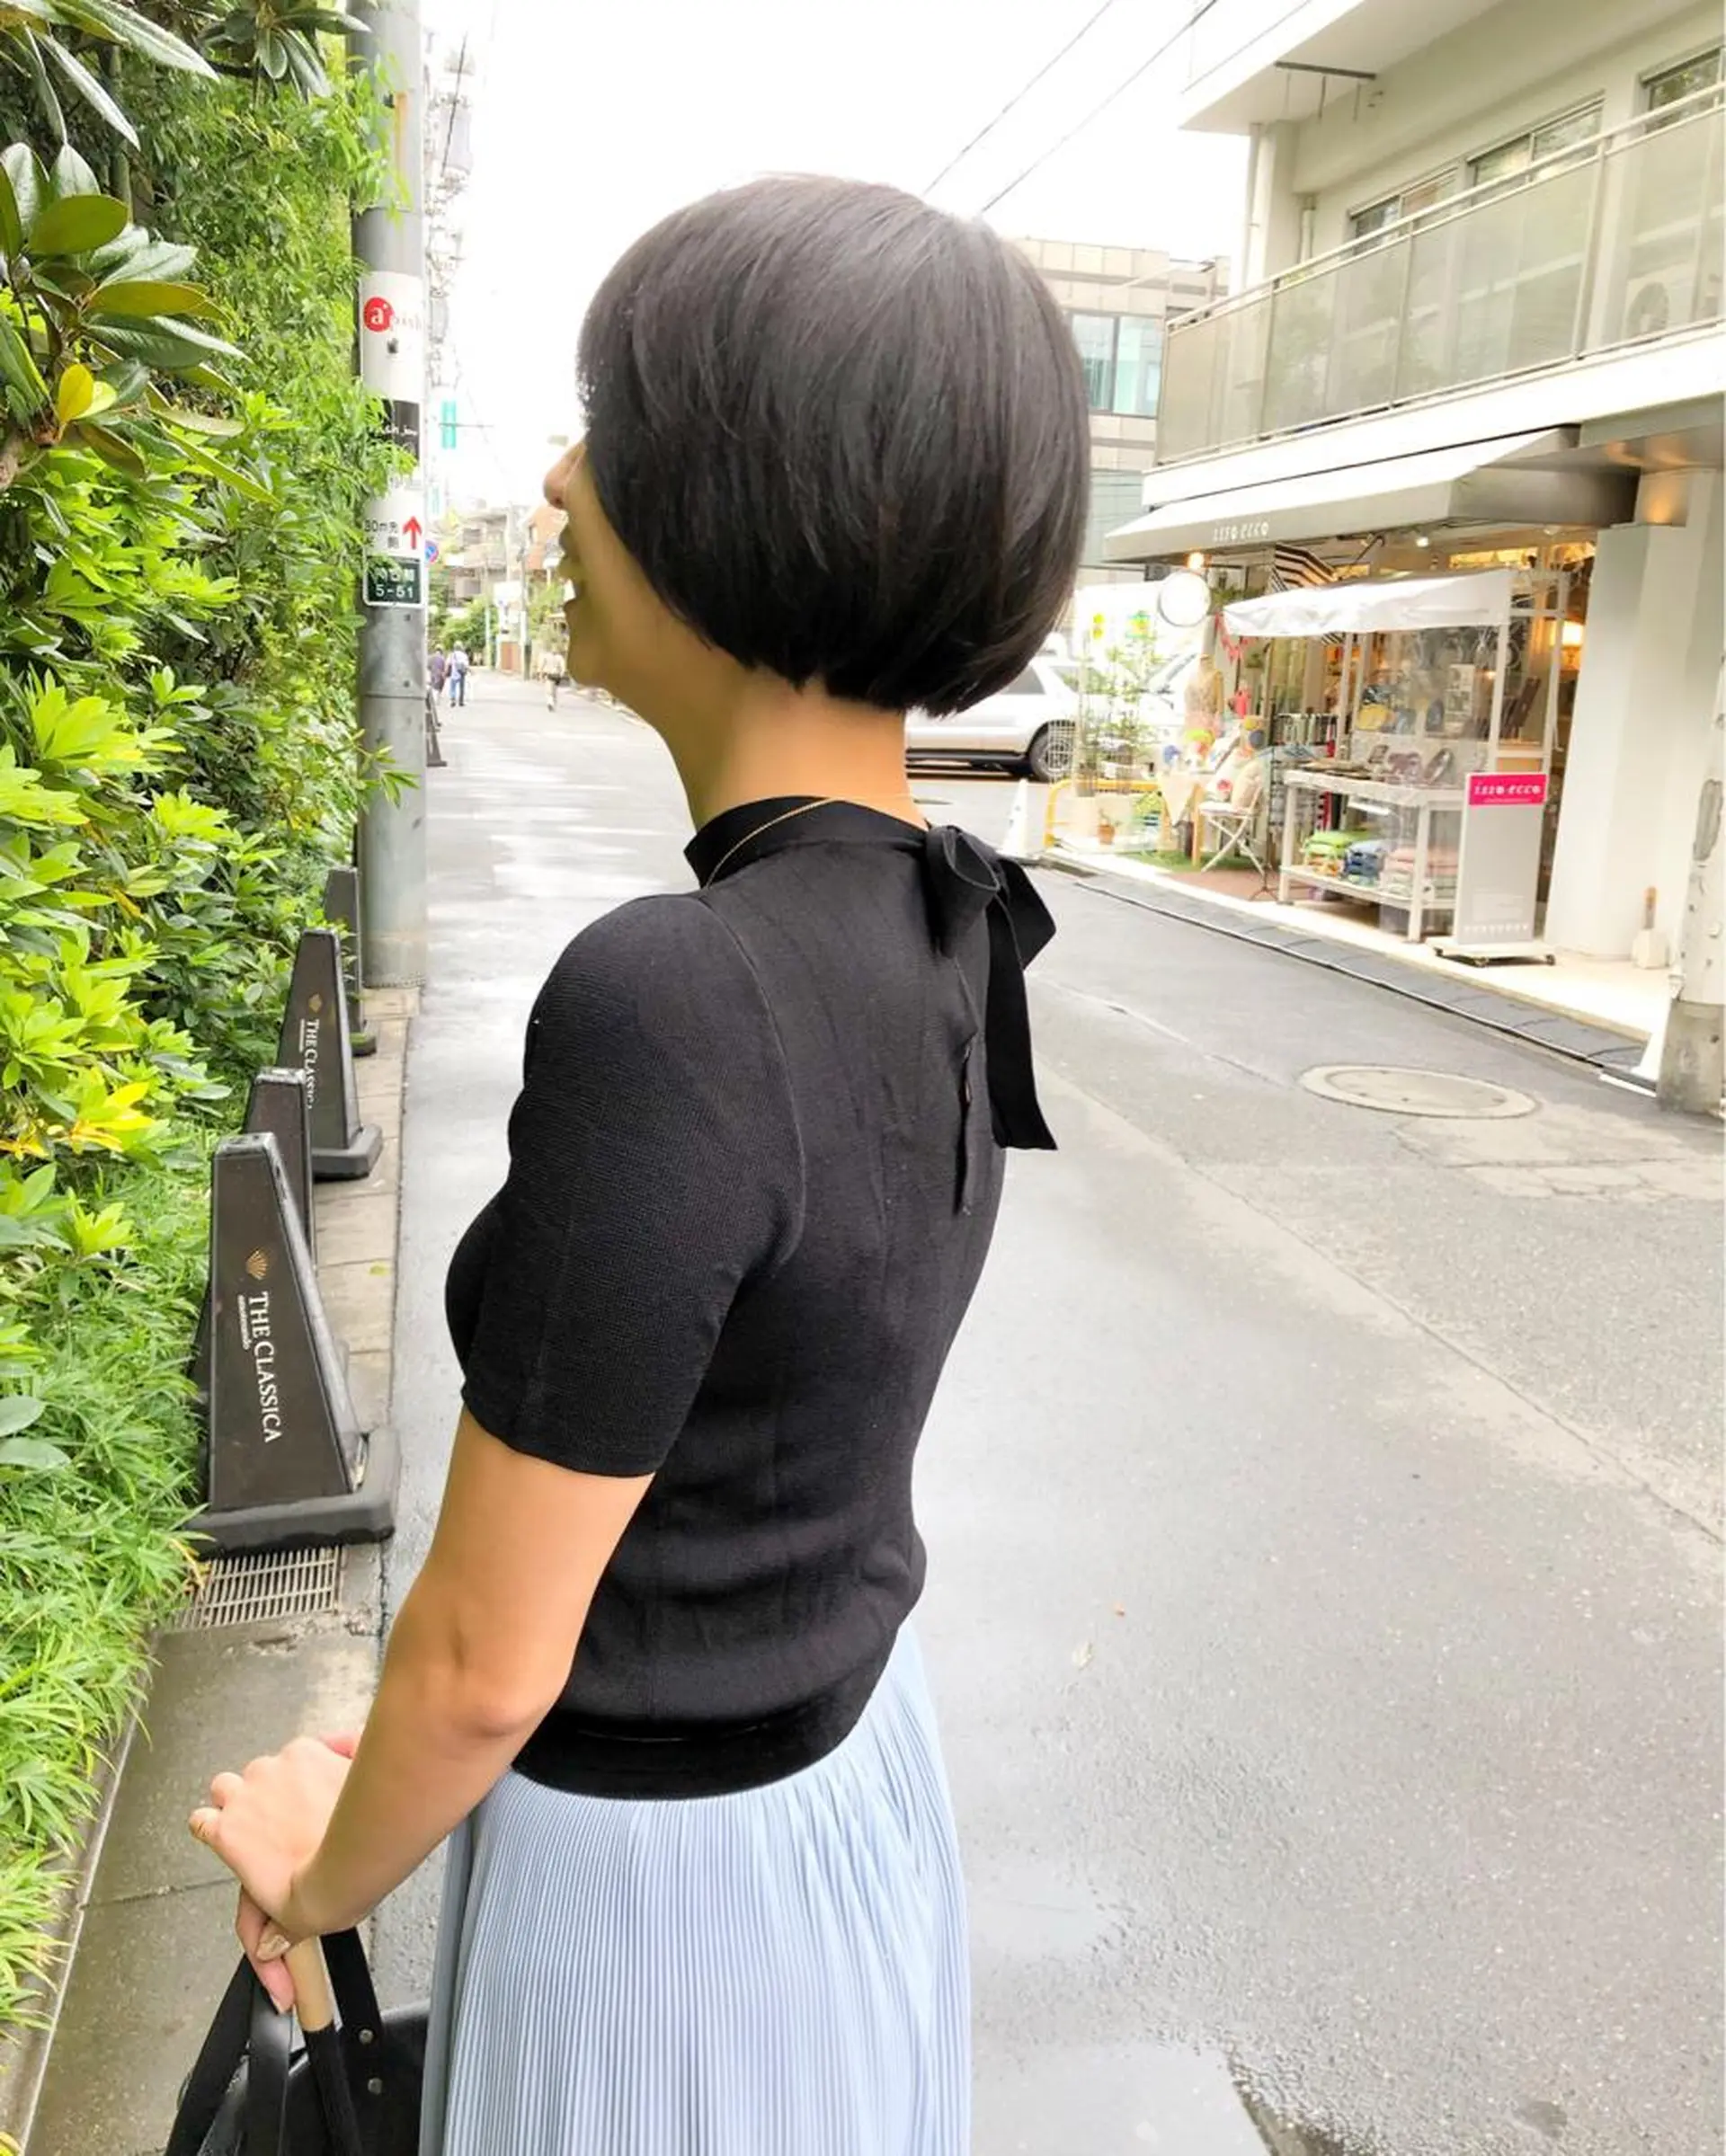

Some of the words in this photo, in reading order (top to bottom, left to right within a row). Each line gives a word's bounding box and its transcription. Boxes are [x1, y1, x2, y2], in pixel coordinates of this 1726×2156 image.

[306, 1018, 320, 1047] THE
[248, 1291, 271, 1339] THE
[254, 1341, 283, 1443] CLASSICA
